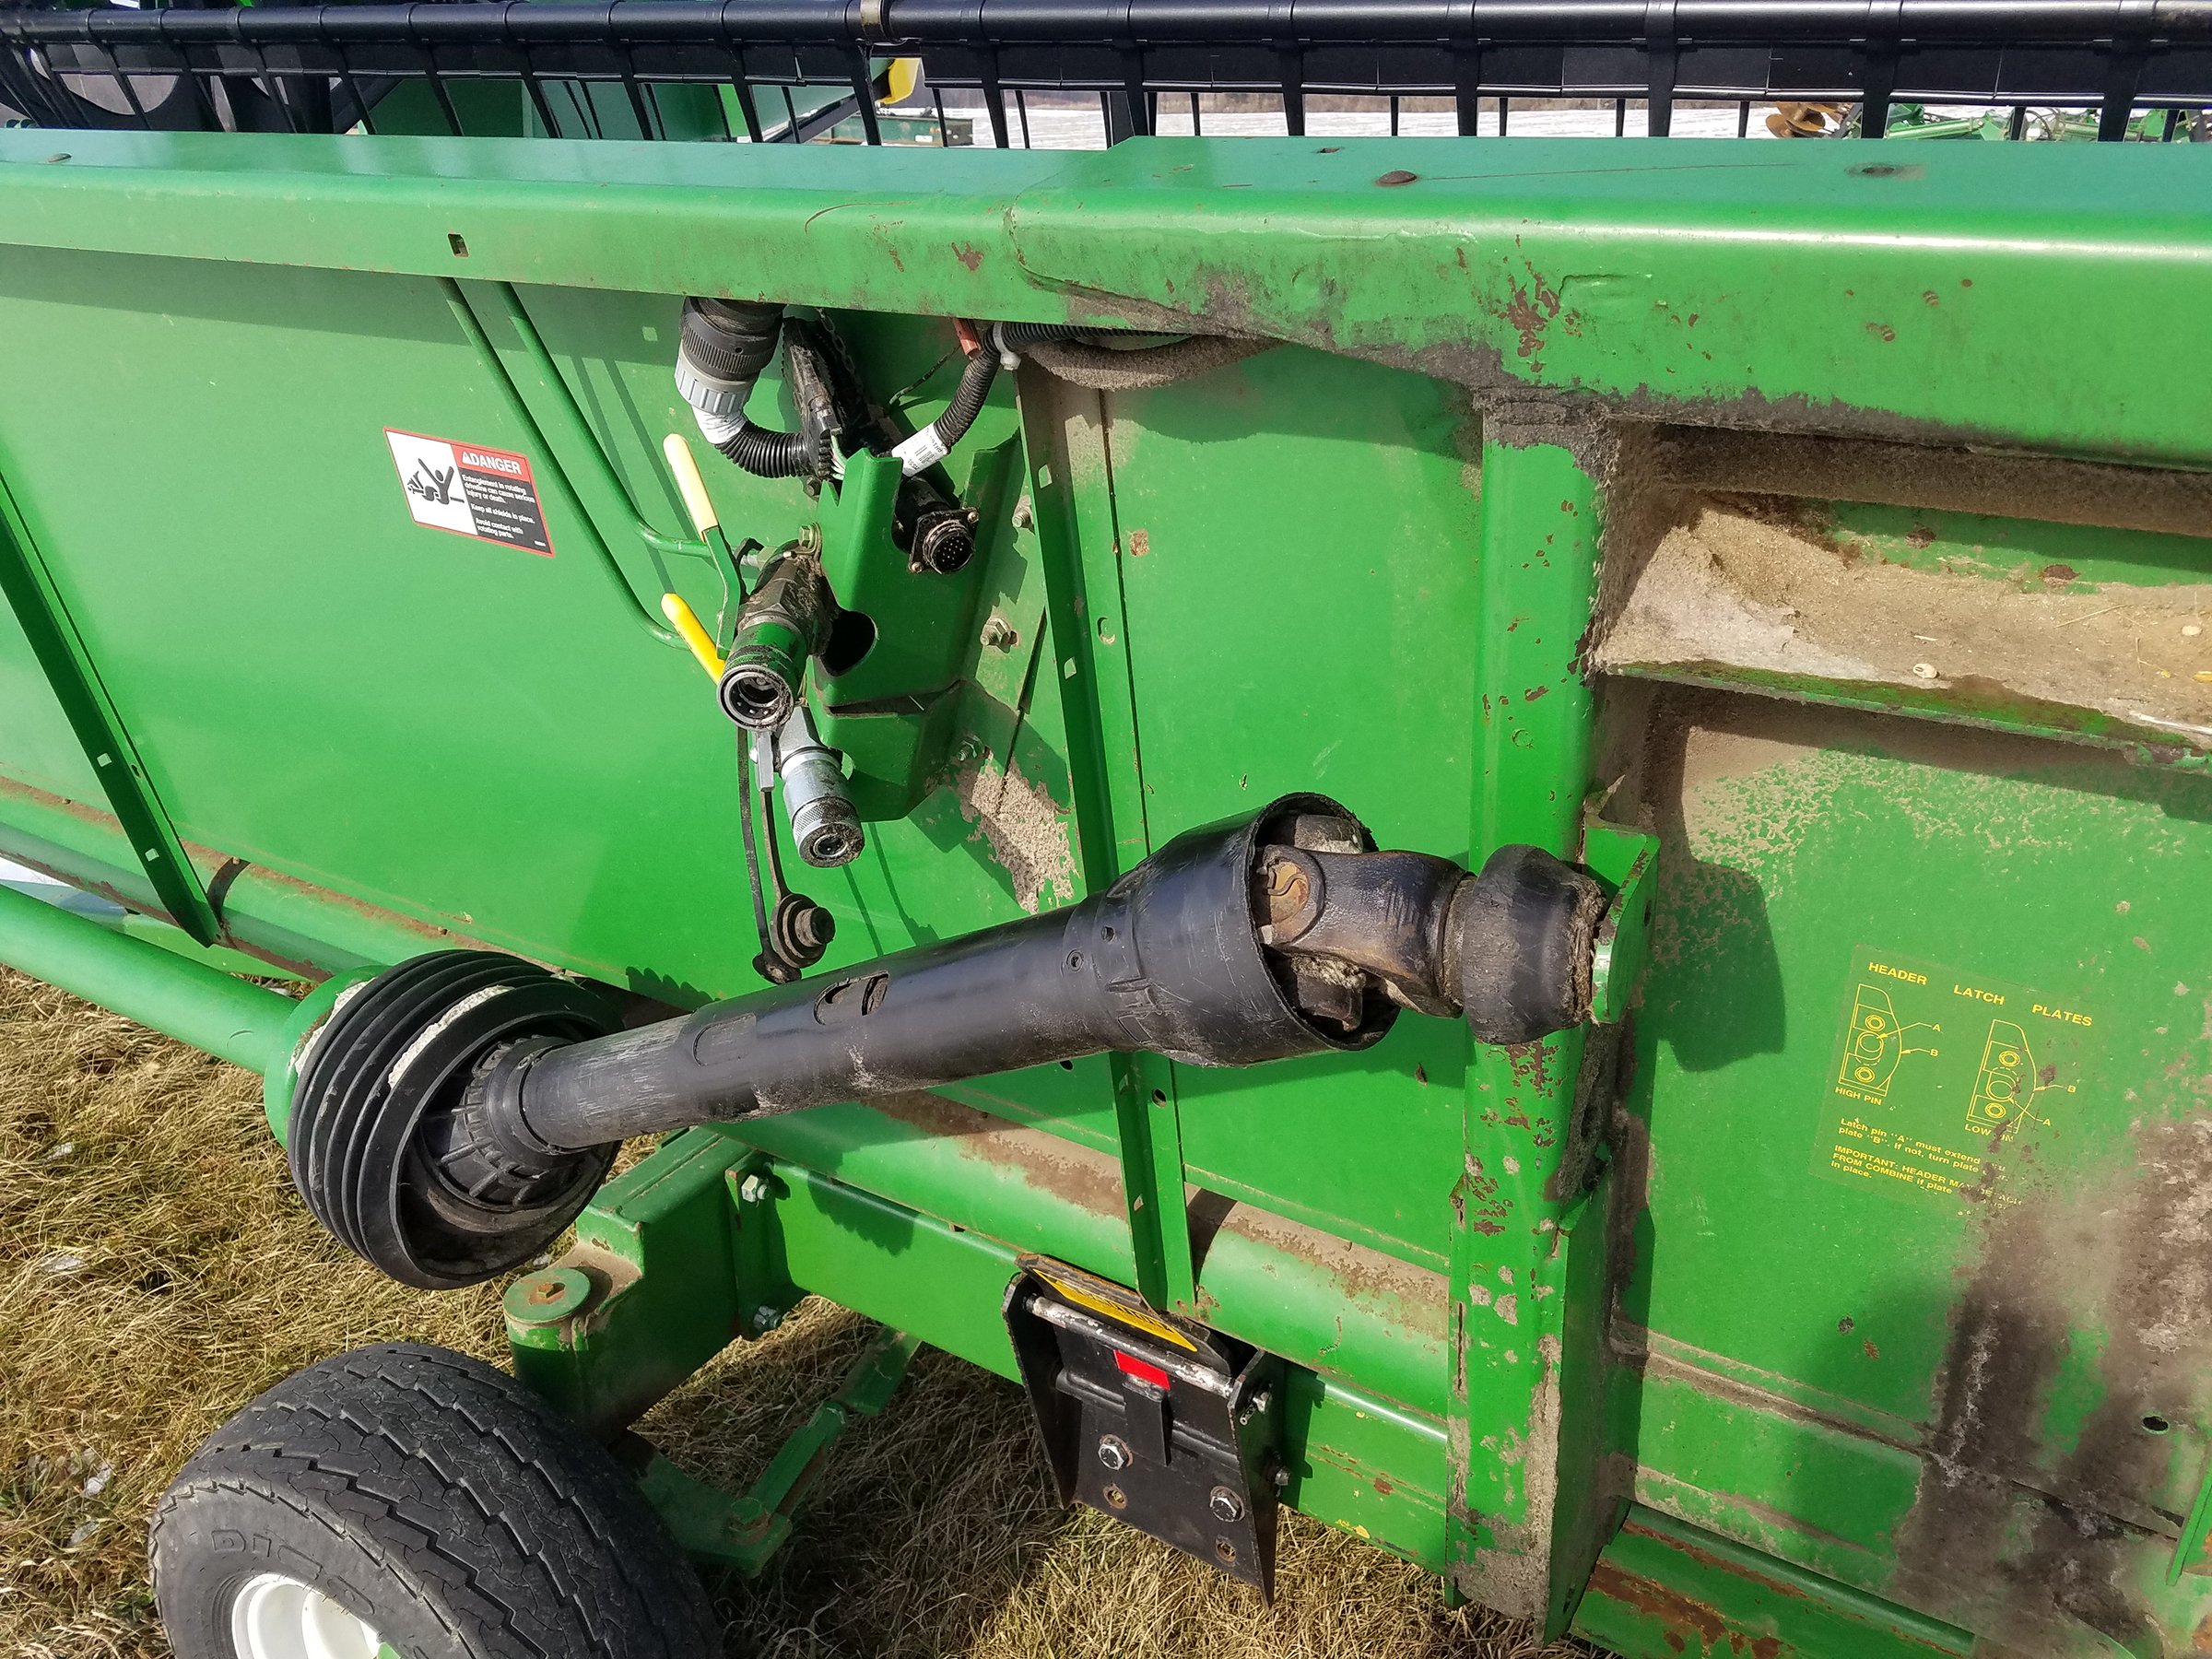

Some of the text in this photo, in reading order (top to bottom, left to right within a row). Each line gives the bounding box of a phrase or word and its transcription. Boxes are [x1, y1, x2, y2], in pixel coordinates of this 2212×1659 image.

[469, 452, 522, 475] DANGER
[505, 485, 527, 496] rotating
[514, 494, 535, 503] serious
[477, 525, 498, 535] rotating
[1868, 962, 2093, 1027] HEADER LATCH PLATES
[1932, 1024, 1941, 1032] A
[1835, 1087, 1883, 1106] HIGH PIN
[2066, 1085, 2077, 1093] B
[2042, 1118, 2052, 1126] A
[1840, 1118, 1868, 1132] Latch
[1871, 1127, 1888, 1137] pin
[1915, 1141, 1942, 1153] must
[1945, 1149, 1981, 1164] extend
[1964, 1124, 2014, 1142] LOW IN
[1839, 1127, 1864, 1139] plate
[1904, 1147, 1924, 1158] not,
[1928, 1153, 1950, 1164] turn
[1953, 1160, 1979, 1173] plate
[1832, 1152, 1863, 1167] FROM
[1865, 1162, 1913, 1182] COMBINE
[1926, 1182, 1953, 1194] plate
[1834, 1145, 1899, 1170] IMPORTANT:
[1902, 1165, 1946, 1183] HEADER
[1842, 1165, 1872, 1179] place.
